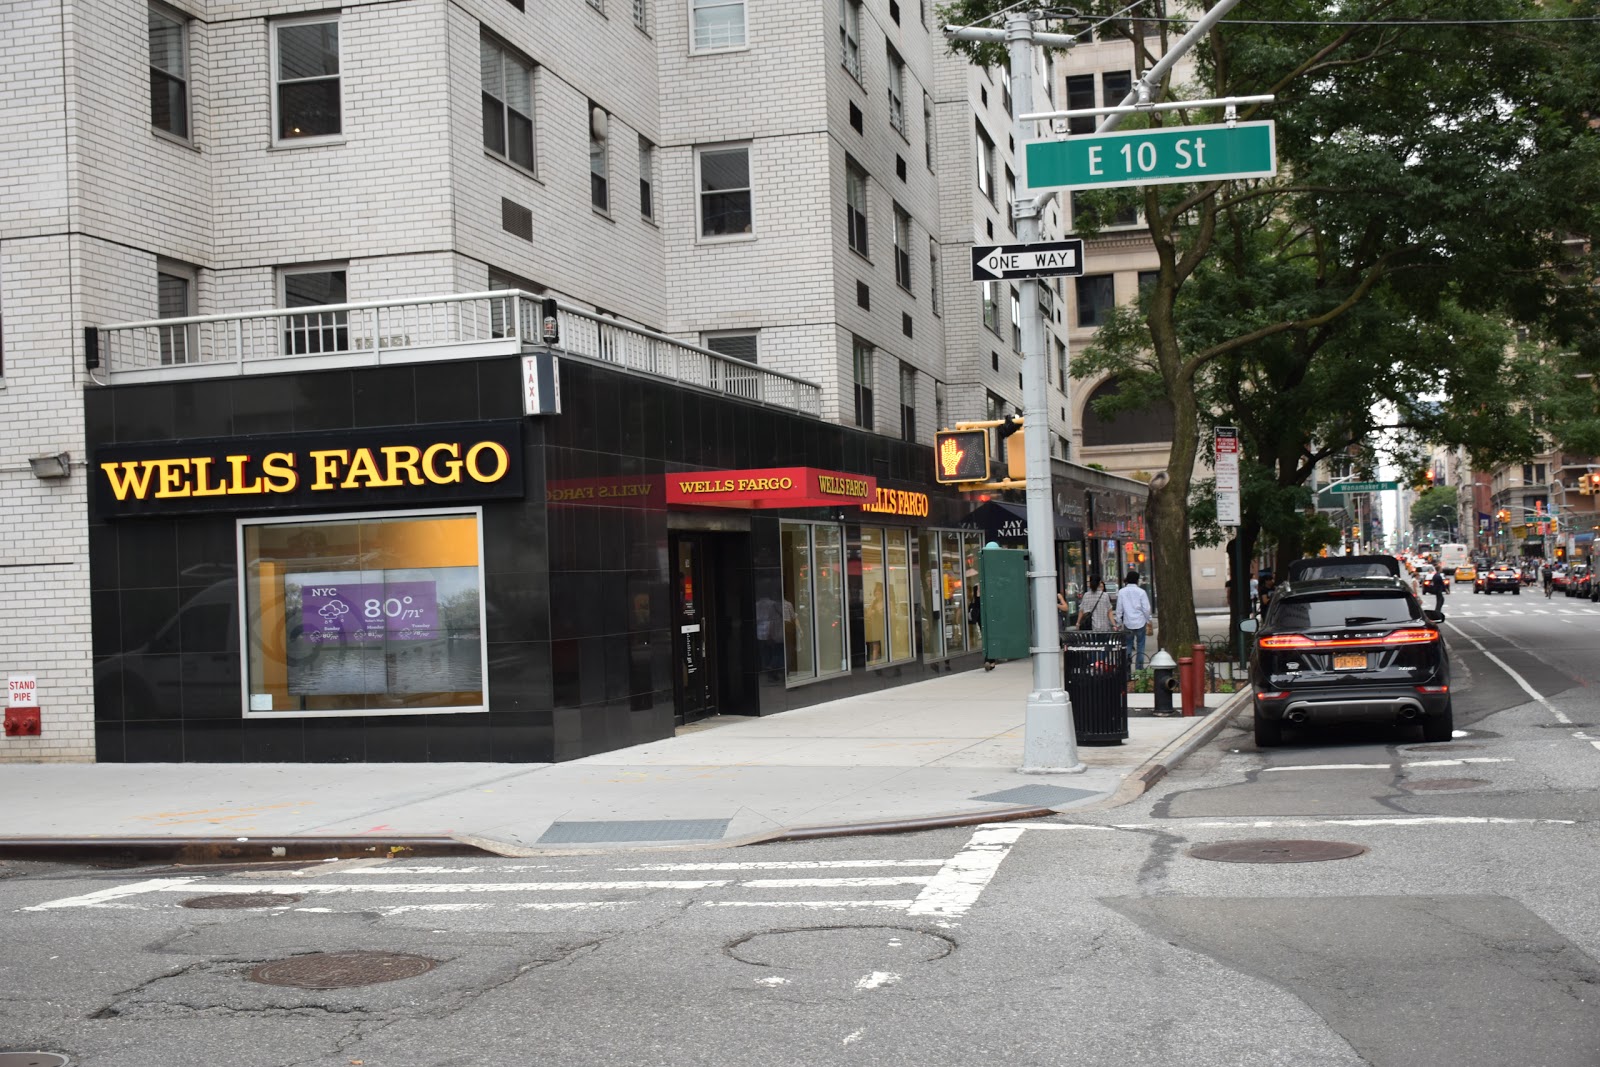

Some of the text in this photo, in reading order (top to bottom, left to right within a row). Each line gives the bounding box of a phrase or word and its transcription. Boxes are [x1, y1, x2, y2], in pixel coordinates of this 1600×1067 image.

[1088, 137, 1207, 175] E 10 St
[989, 252, 1068, 270] ONE WAY
[527, 360, 535, 411] TAXI
[101, 441, 511, 500] WELLS FARGO
[679, 477, 792, 494] WELLS FARGO
[819, 475, 869, 497] WELLS FARGO
[863, 487, 929, 517] LLS FARGO
[997, 528, 1029, 537] NAILS
[1003, 520, 1023, 529] JAY
[312, 588, 337, 597] NYC
[1313, 632, 1384, 640] LINCOLN
[9, 680, 35, 690] STAND
[13, 692, 32, 702] PIPE
